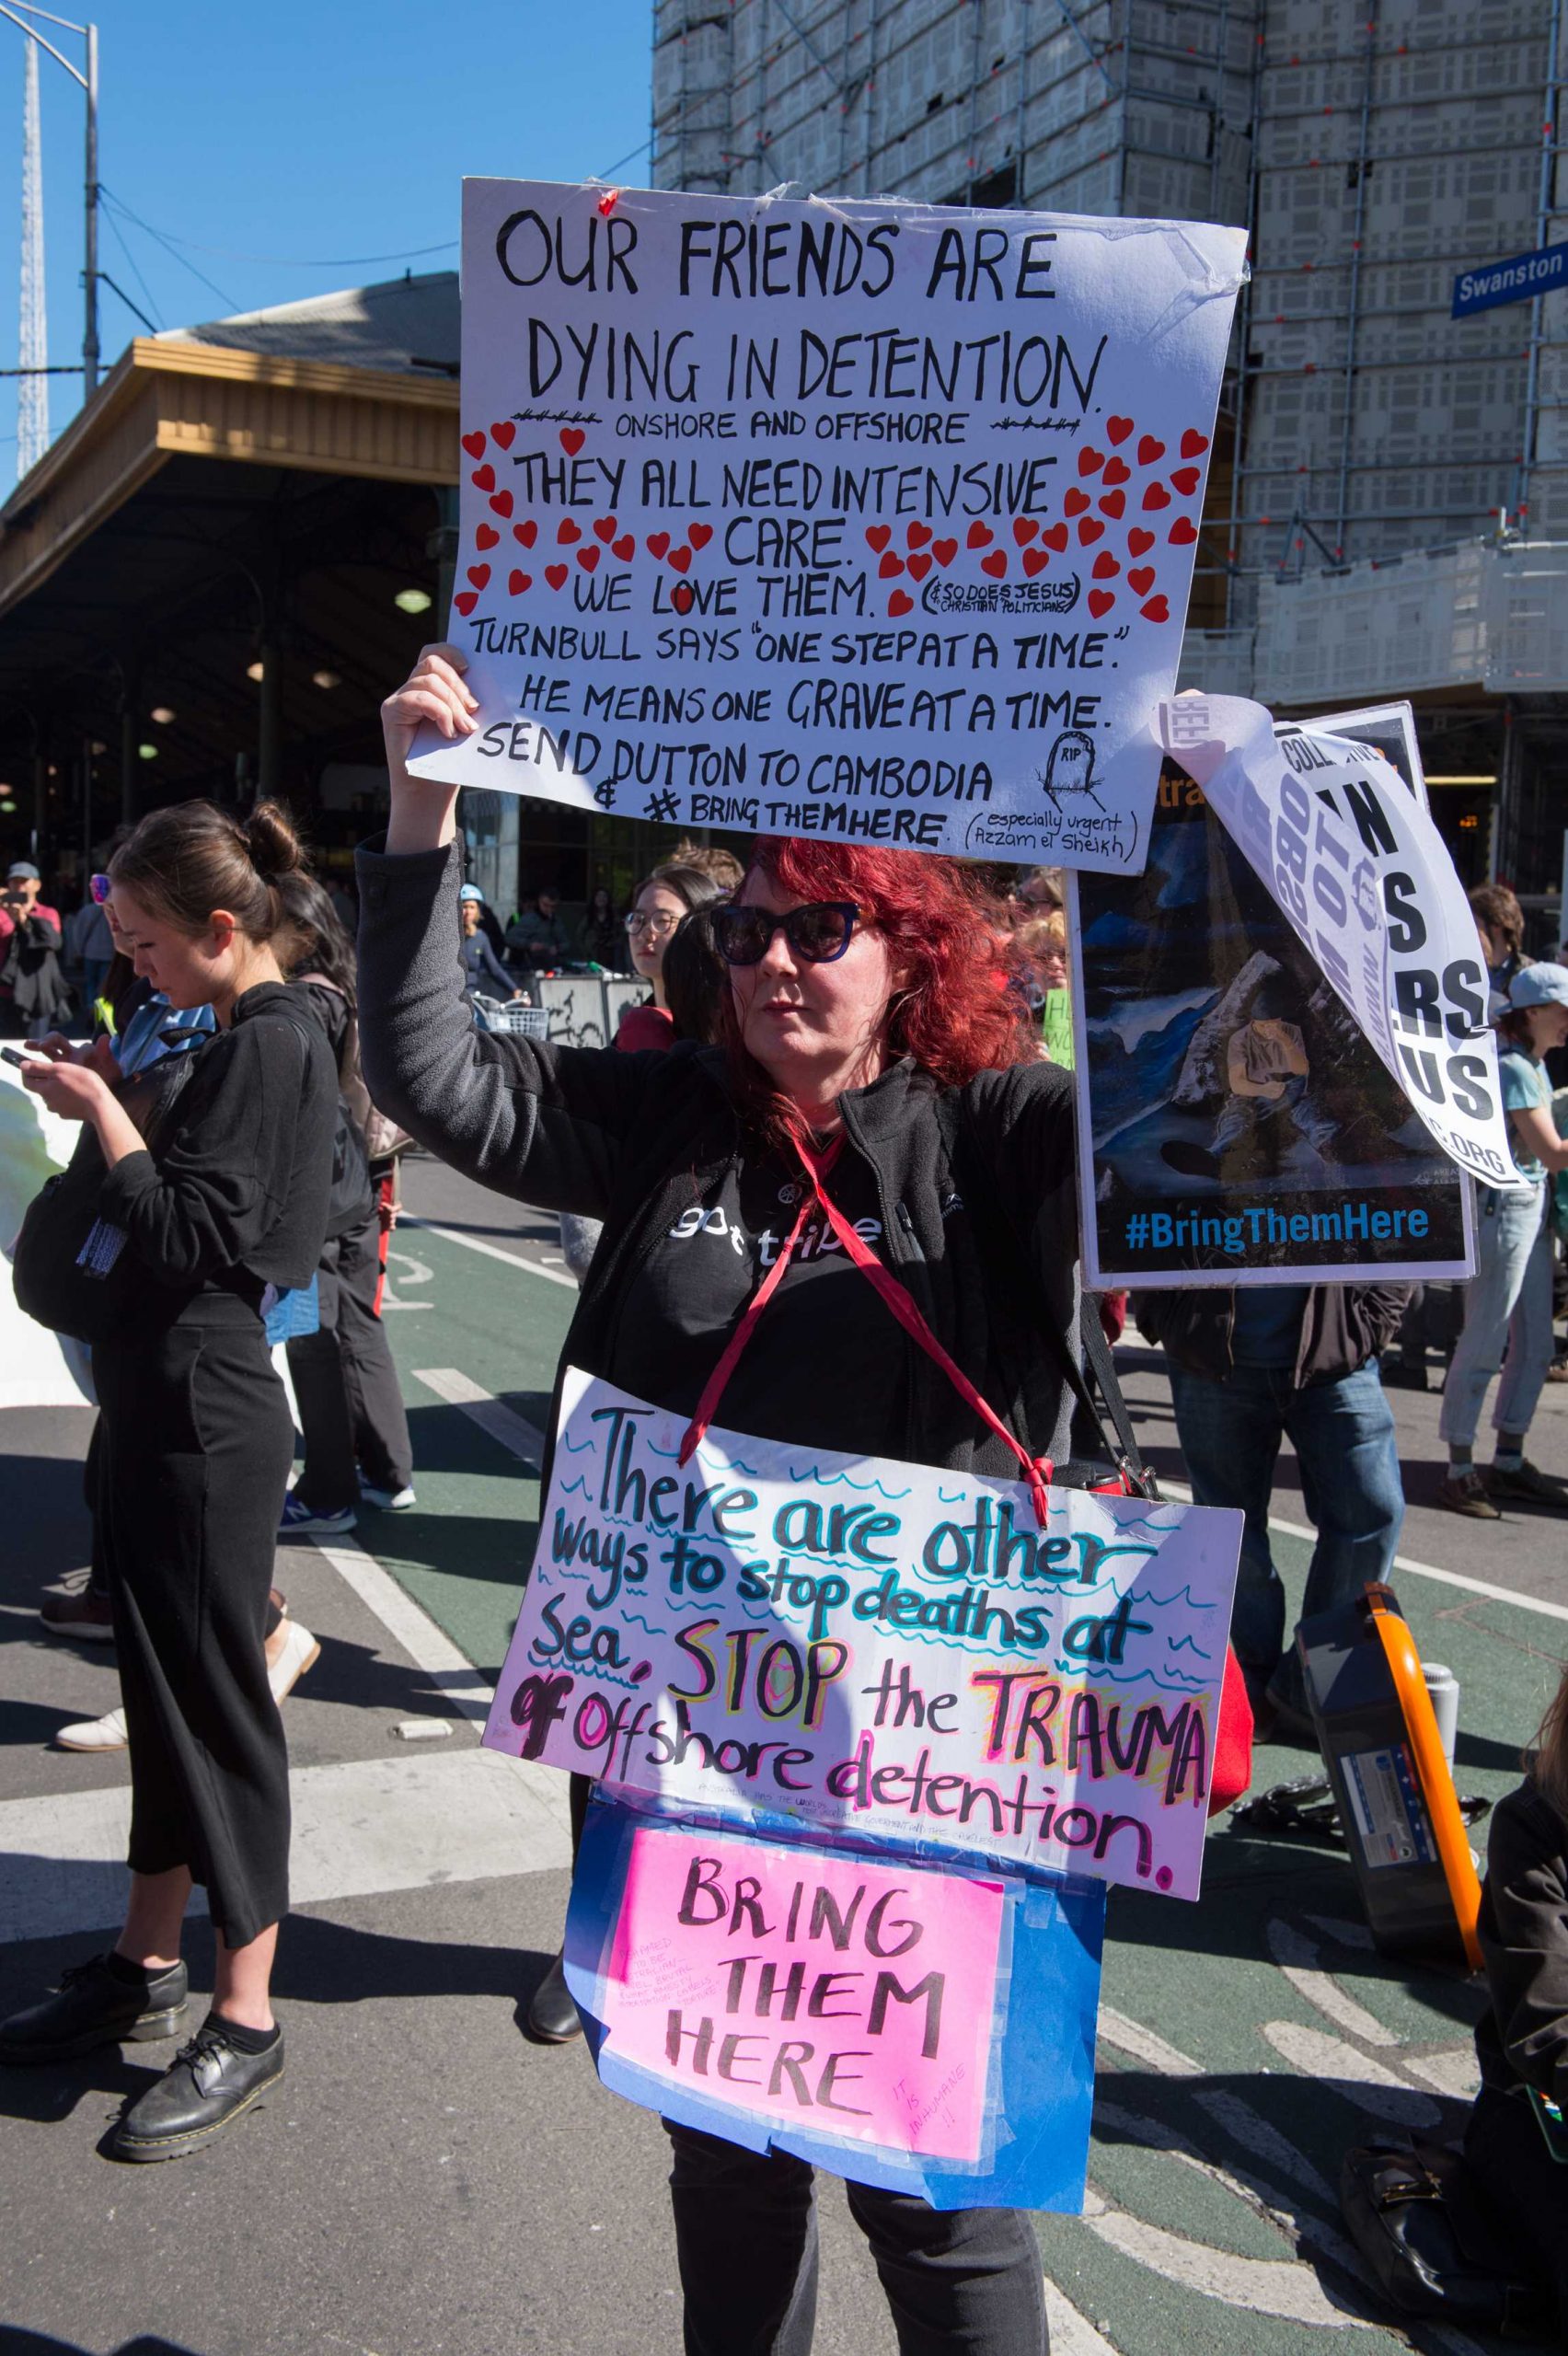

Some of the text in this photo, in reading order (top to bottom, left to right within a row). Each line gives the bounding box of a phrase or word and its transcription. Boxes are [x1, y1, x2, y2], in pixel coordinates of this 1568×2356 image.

[495, 209, 1058, 302] OUR FRIENDS ARE
[1459, 253, 1562, 302] Swanston
[527, 317, 1109, 414] DYING IN DETENTION.
[615, 410, 971, 445] ONSHORE AND OFFSHORE
[513, 451, 1058, 519] THEY ALL NEED INTENSIVE
[724, 515, 854, 569] CARE.
[573, 571, 875, 618] WE LOVE THEM.
[942, 583, 964, 599] SO
[967, 583, 1011, 600] DOES
[469, 618, 641, 660] TURNBULL
[656, 628, 742, 662] SAYS
[831, 630, 918, 665] STEP
[917, 632, 969, 668] AT
[972, 632, 999, 669] A
[519, 674, 1112, 733] HE MEANS ONE GRAVE AT A TIME.
[477, 722, 993, 801] SEND DUTTON TO CAMBODIA
[1060, 747, 1082, 762] RIP
[974, 827, 1036, 849] Azzam
[1067, 814, 1123, 838] urgent
[1125, 1204, 1429, 1253] #BringThemHere
[591, 1406, 1159, 1585] There are other
[660, 1539, 727, 1594] to
[736, 1558, 849, 1642] stop
[852, 1568, 1054, 1649] deaths
[1062, 1599, 1154, 1665] at
[667, 1618, 853, 1732] STOP
[861, 1657, 959, 1734] the
[971, 1668, 1207, 1808] TRAUMA
[826, 1728, 1174, 1891] detention.
[677, 1854, 924, 1958] BRING
[718, 1954, 945, 2060] THEM
[664, 2009, 874, 2116] HERE
[893, 2079, 905, 2100] IT
[906, 2094, 920, 2110] IS
